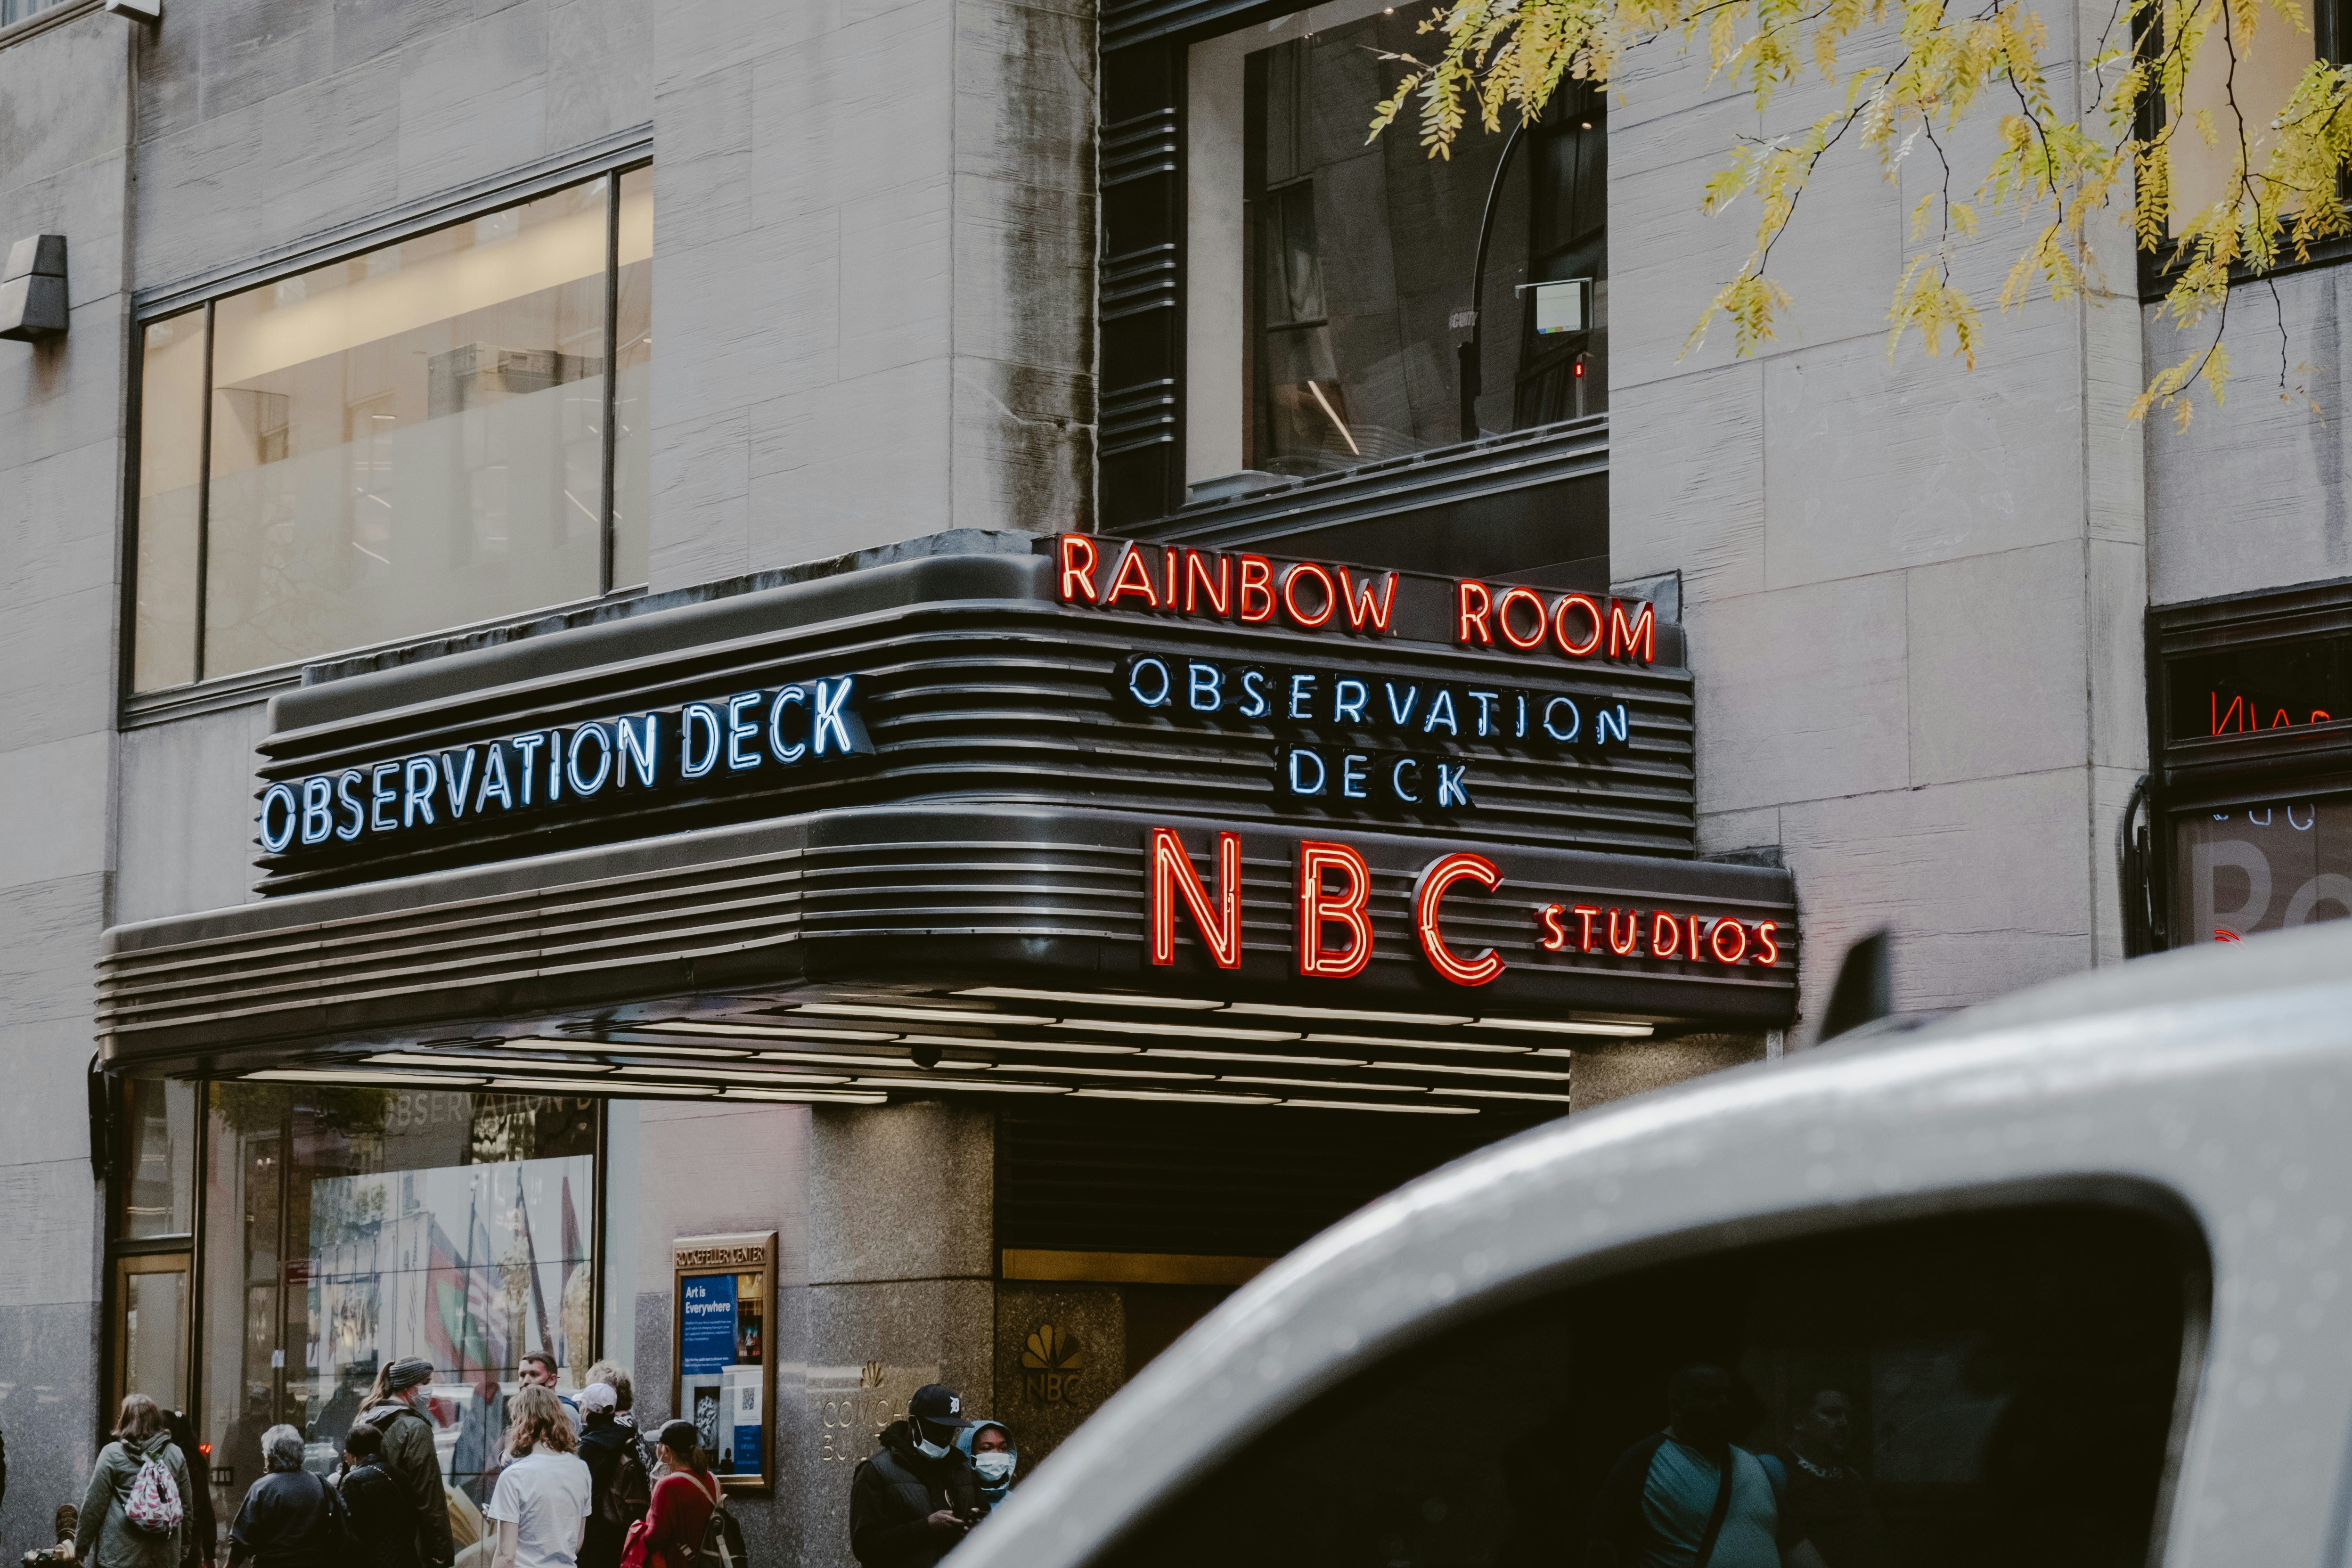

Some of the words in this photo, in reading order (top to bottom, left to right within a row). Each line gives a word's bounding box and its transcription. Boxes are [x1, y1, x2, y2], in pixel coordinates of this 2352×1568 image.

[1061, 533, 1398, 632] RAINBOW
[1459, 579, 1655, 663] ROOM
[1129, 659, 1627, 745] OBSERVATION
[258, 713, 656, 853] OBSERVATION
[681, 677, 853, 778] DECK
[1290, 750, 1468, 808] DECK
[1153, 828, 1506, 987] NBC
[1539, 903, 1779, 968] STUDIOS
[676, 1249, 730, 1266] ROCKEFELLER
[732, 1245, 764, 1263] CENTER
[686, 1286, 698, 1298] Art
[699, 1285, 706, 1298] is
[686, 1300, 731, 1316] Everywhere
[1026, 1373, 1080, 1403] NBC
